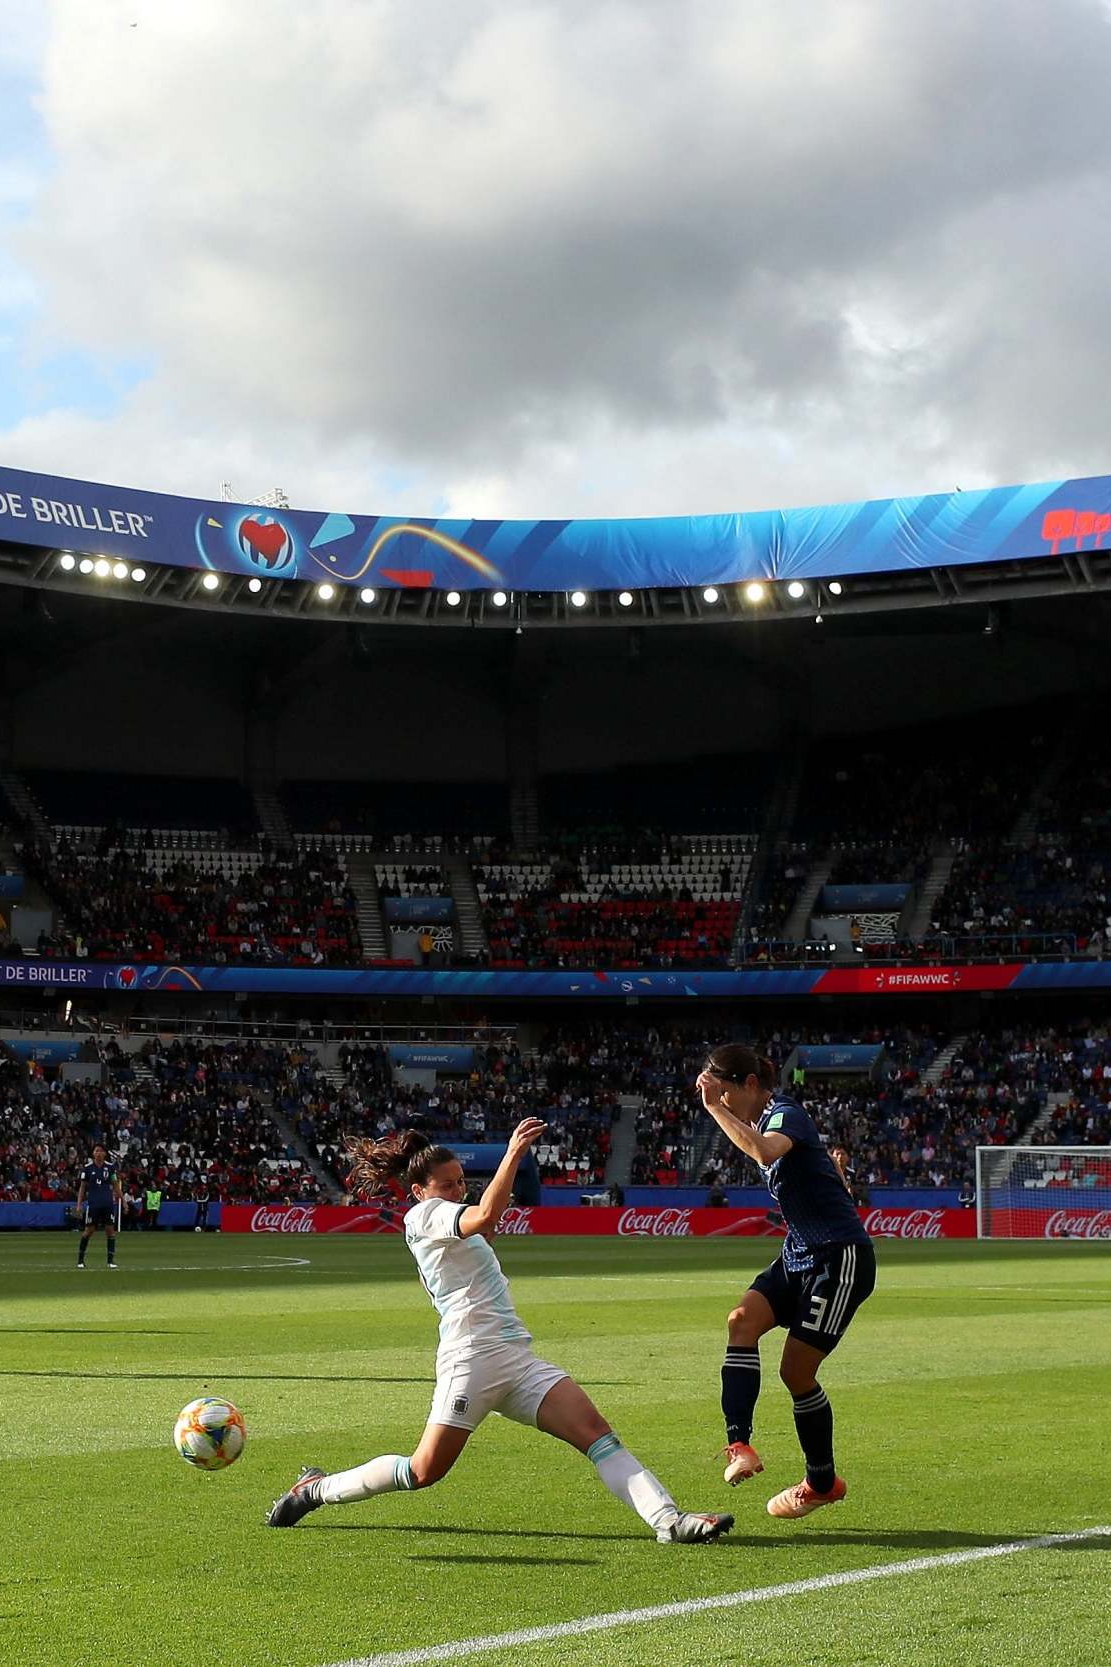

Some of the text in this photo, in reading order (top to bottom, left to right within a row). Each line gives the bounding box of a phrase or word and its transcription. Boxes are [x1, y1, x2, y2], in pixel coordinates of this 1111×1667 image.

[6, 966, 24, 980] DE
[889, 974, 949, 985] #FIFAWWC
[251, 1206, 317, 1232] Coca-Cola
[617, 1207, 693, 1236] Coca-Cola
[801, 1295, 828, 1332] 3
